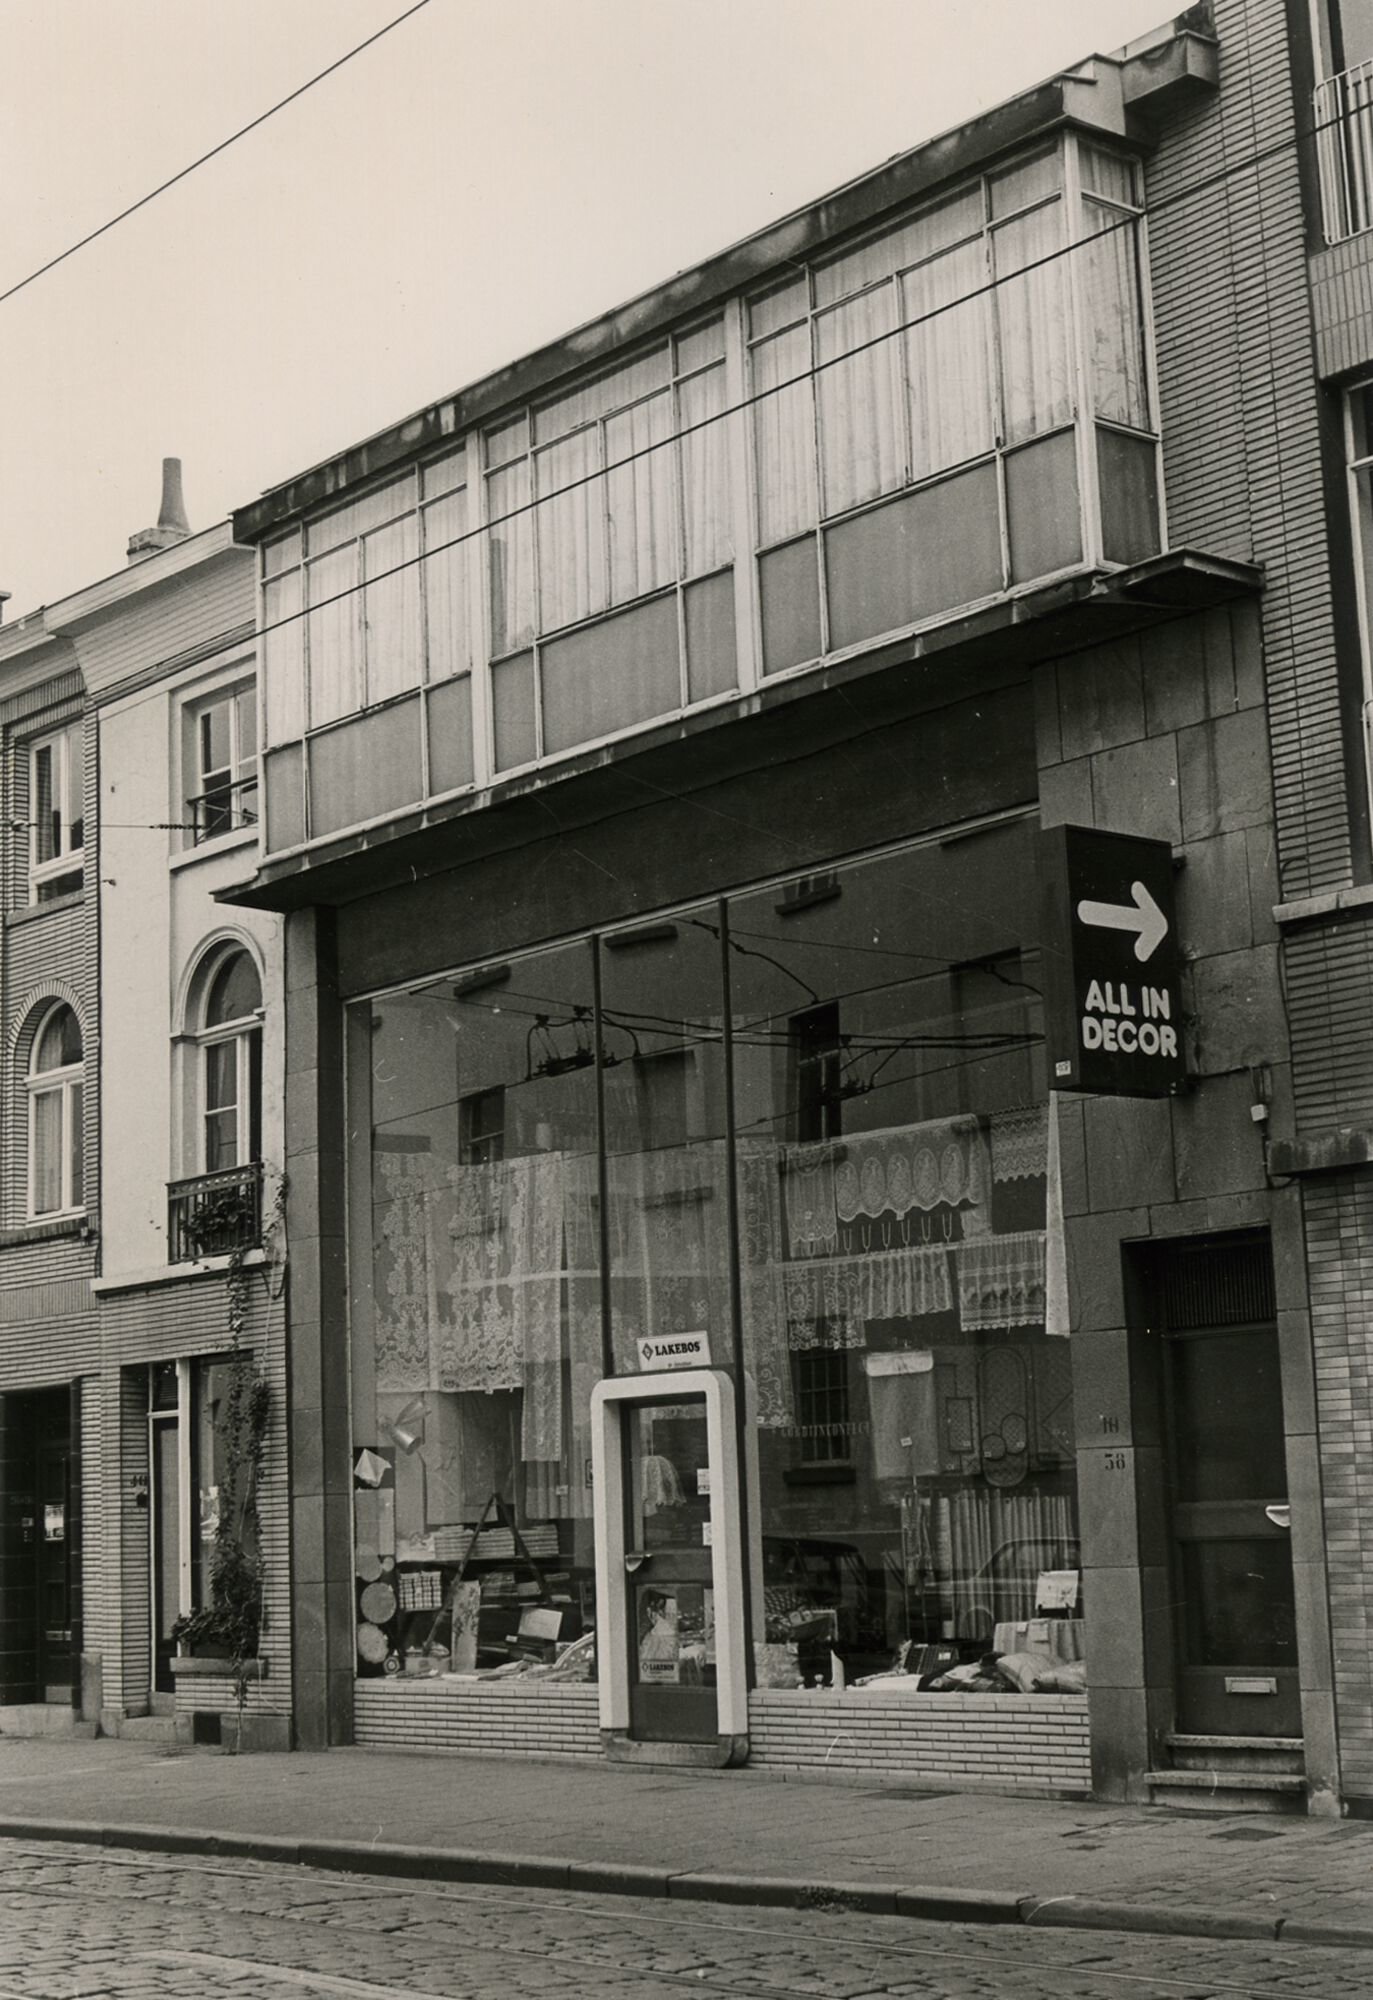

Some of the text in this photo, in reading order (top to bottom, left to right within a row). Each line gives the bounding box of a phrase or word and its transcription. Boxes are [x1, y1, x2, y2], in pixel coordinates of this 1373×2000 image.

[1085, 979, 1171, 1020] ALL IN
[1082, 1016, 1178, 1058] DECOR
[655, 1340, 701, 1356] LAKEBOS
